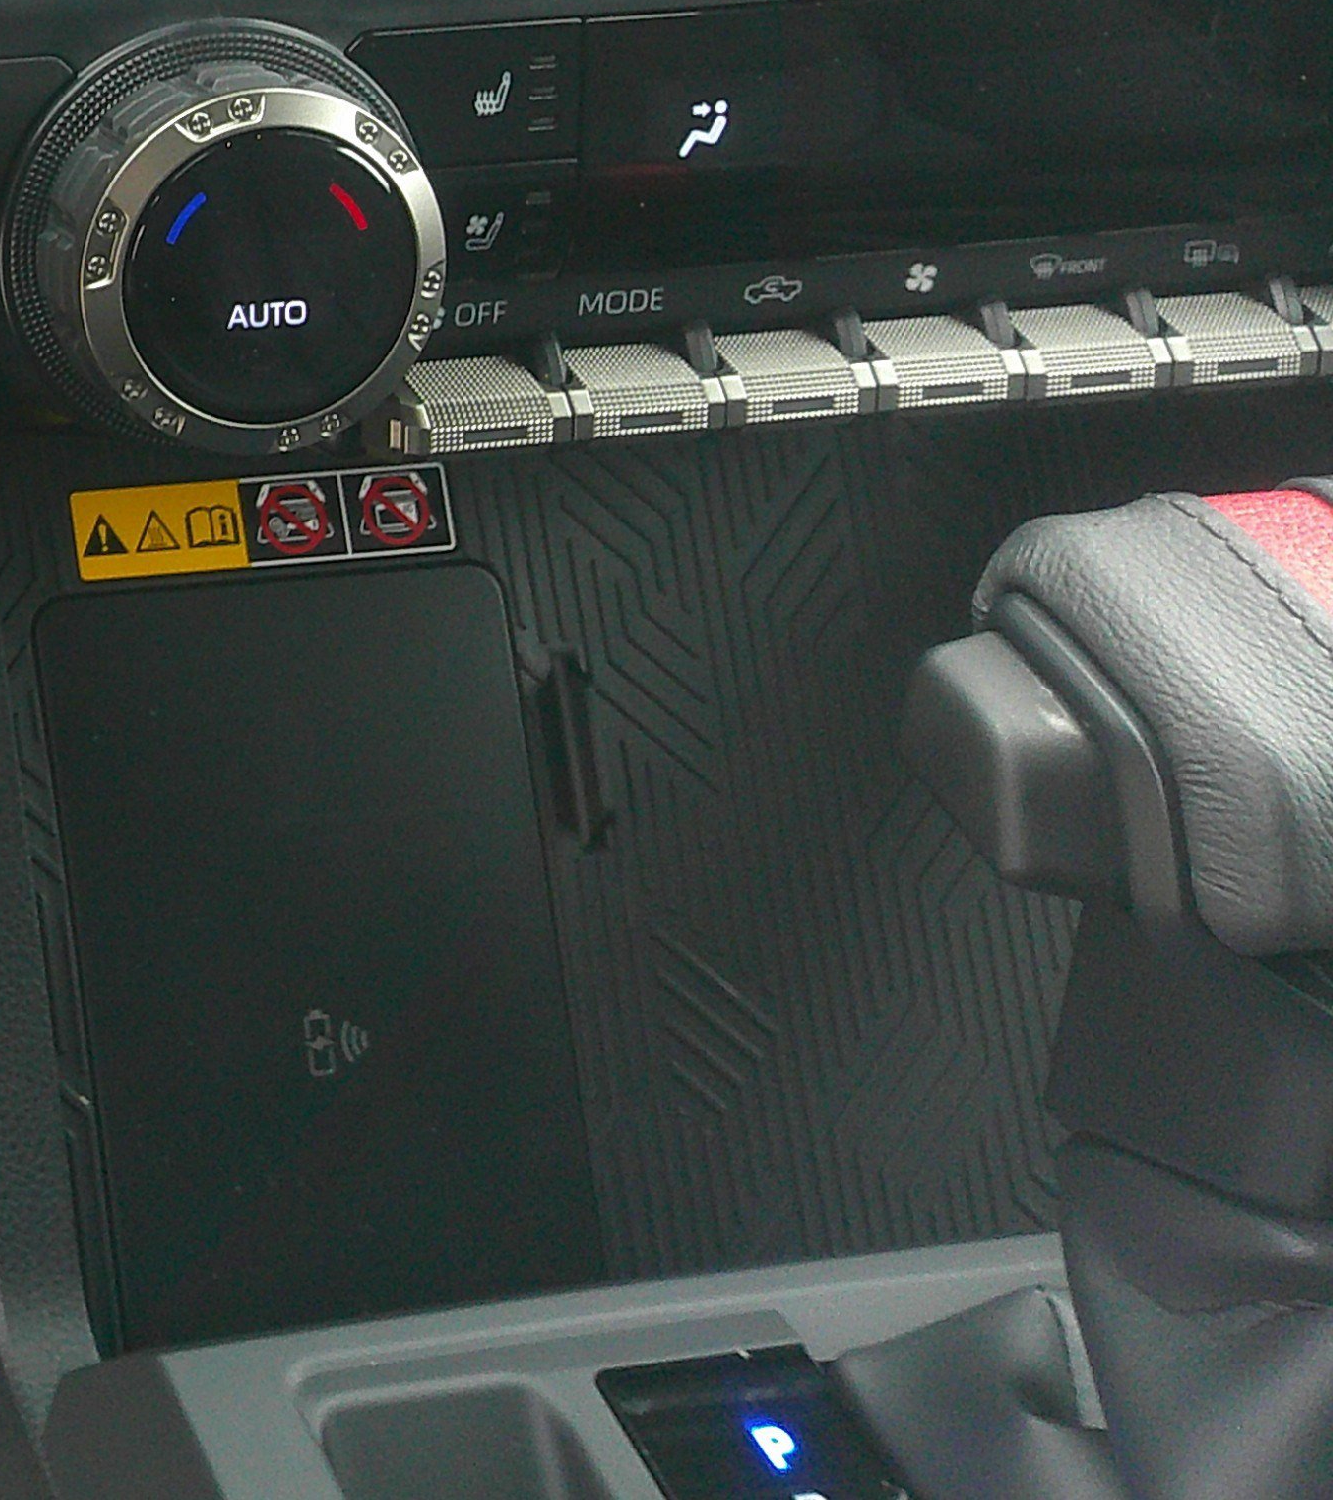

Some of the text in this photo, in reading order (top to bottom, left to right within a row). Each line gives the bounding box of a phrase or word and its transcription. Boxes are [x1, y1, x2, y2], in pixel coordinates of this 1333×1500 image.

[1060, 257, 1107, 274] FRONT
[227, 300, 307, 330] AUTO
[454, 301, 508, 329] OFF
[578, 287, 664, 316] MODE
[751, 1425, 795, 1470] P
